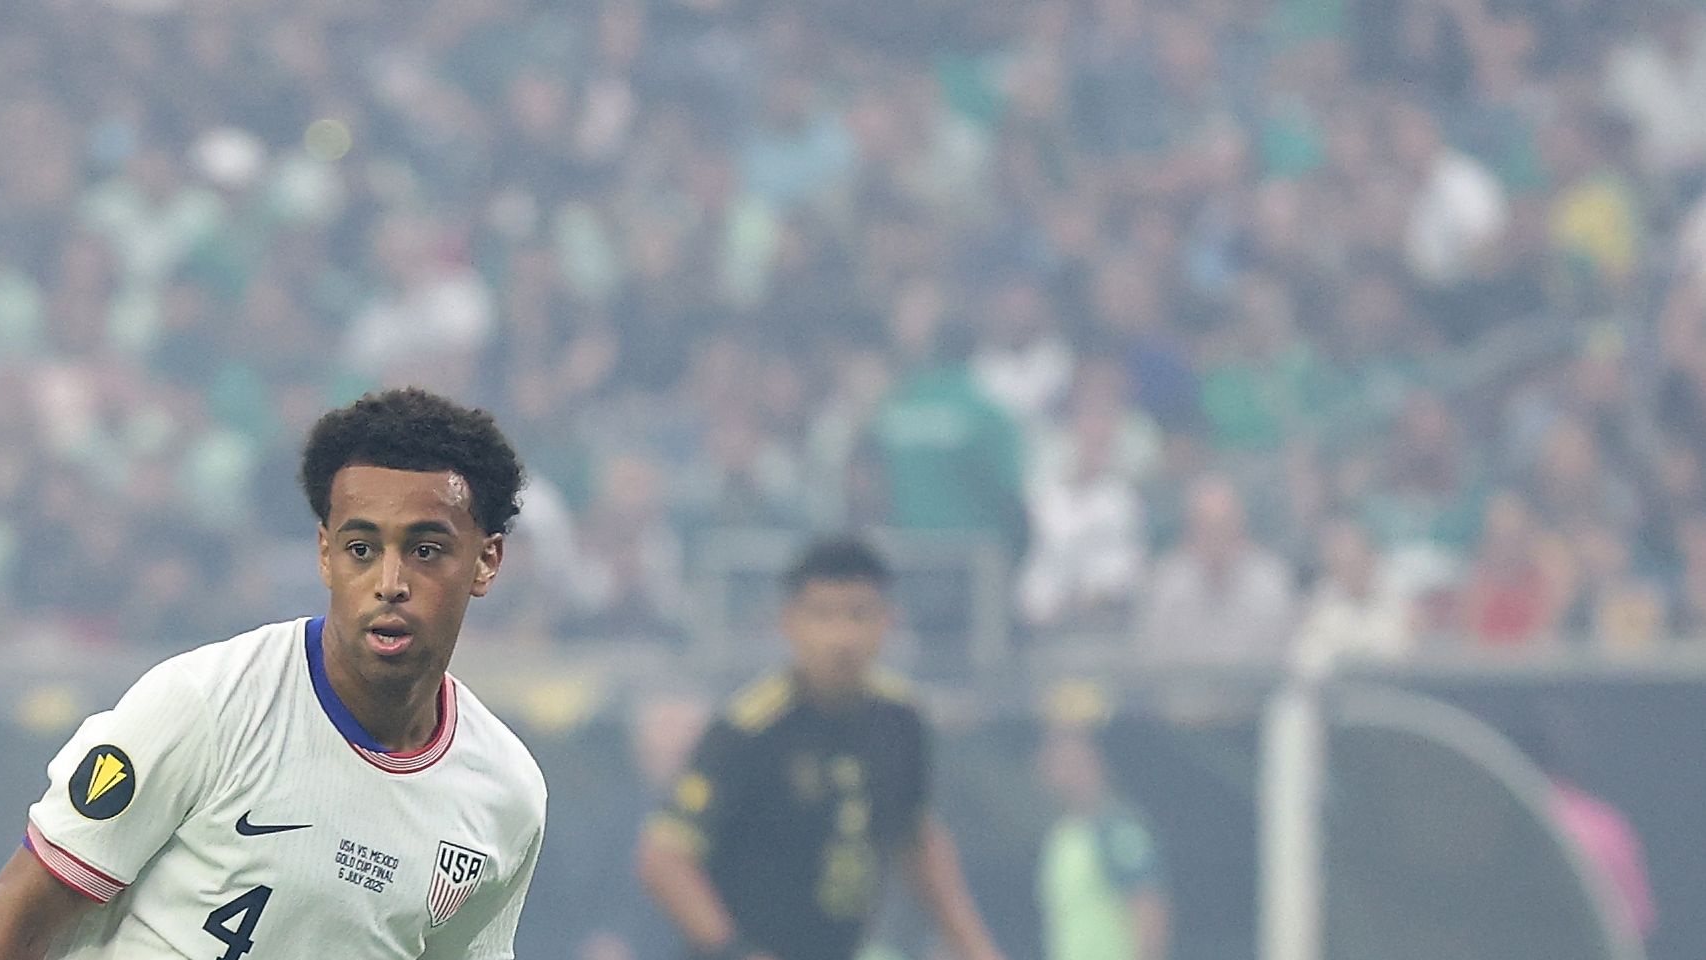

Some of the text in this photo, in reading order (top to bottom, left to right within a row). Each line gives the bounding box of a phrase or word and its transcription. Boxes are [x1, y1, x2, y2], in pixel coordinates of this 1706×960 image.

[335, 852, 394, 883] GOLD CUP FINAL
[339, 839, 355, 854] USA
[369, 849, 399, 870] MEXICO
[439, 847, 482, 884] USA
[344, 870, 365, 885] JULY
[363, 876, 385, 893] 2025
